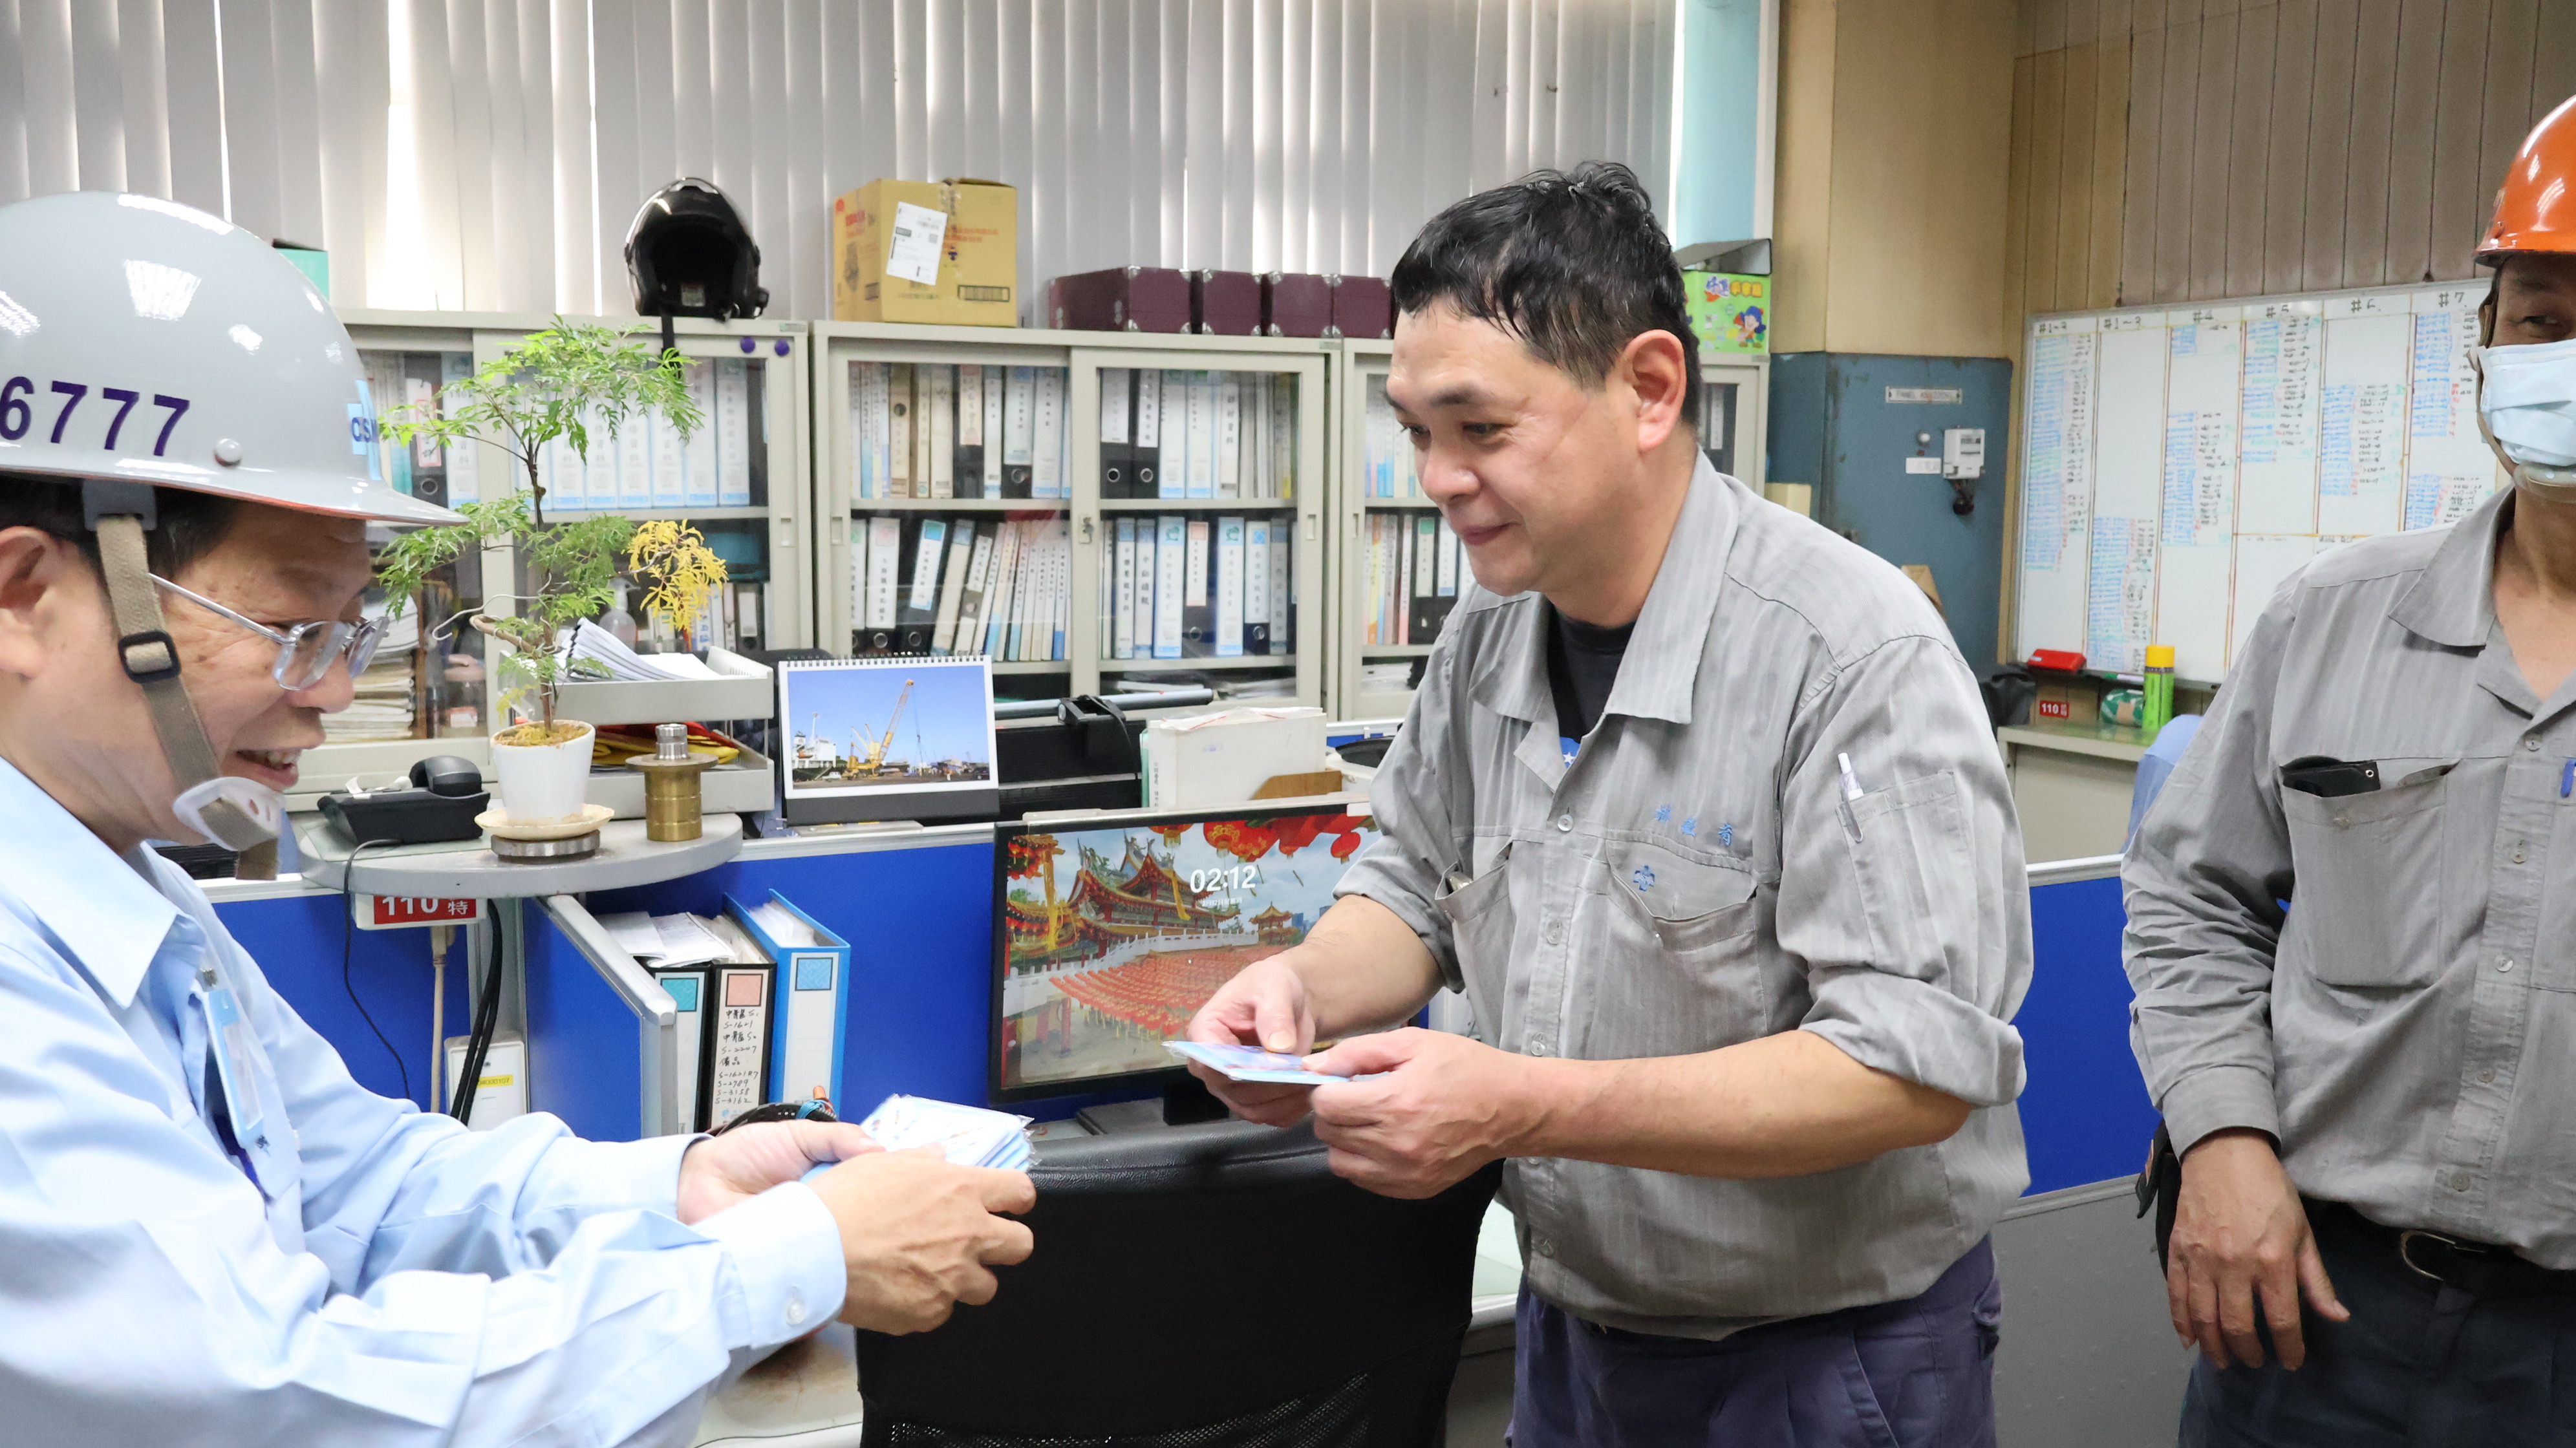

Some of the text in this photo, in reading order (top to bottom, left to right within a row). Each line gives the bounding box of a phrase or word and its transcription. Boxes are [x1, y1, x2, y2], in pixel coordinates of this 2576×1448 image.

[0, 376, 190, 456] 6777
[2041, 703, 2059, 714] 110
[1190, 865, 1256, 893] 02:12
[447, 900, 468, 915] 特
